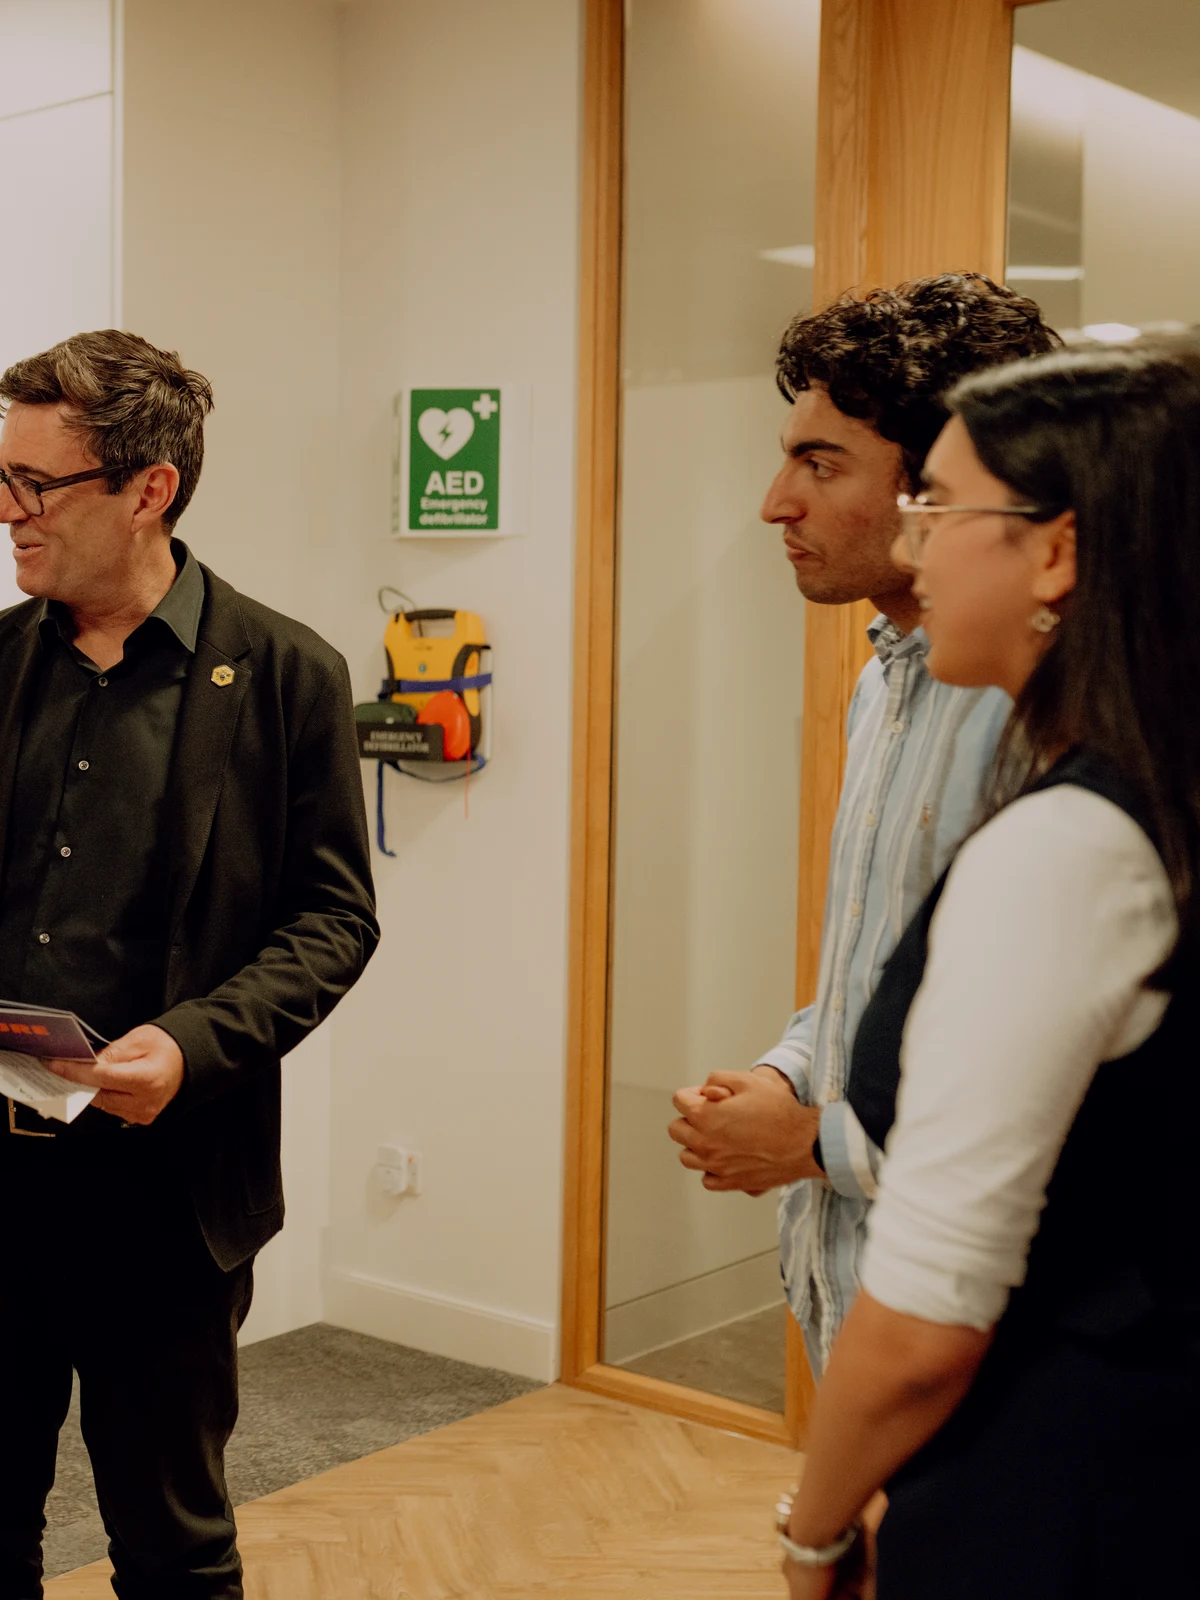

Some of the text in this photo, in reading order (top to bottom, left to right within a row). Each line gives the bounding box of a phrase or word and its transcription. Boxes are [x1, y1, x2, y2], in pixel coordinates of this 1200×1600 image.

[425, 470, 484, 495] AED
[420, 497, 488, 512] Emergency
[419, 512, 488, 525] defibrillator
[370, 731, 423, 742] EMERGENCY
